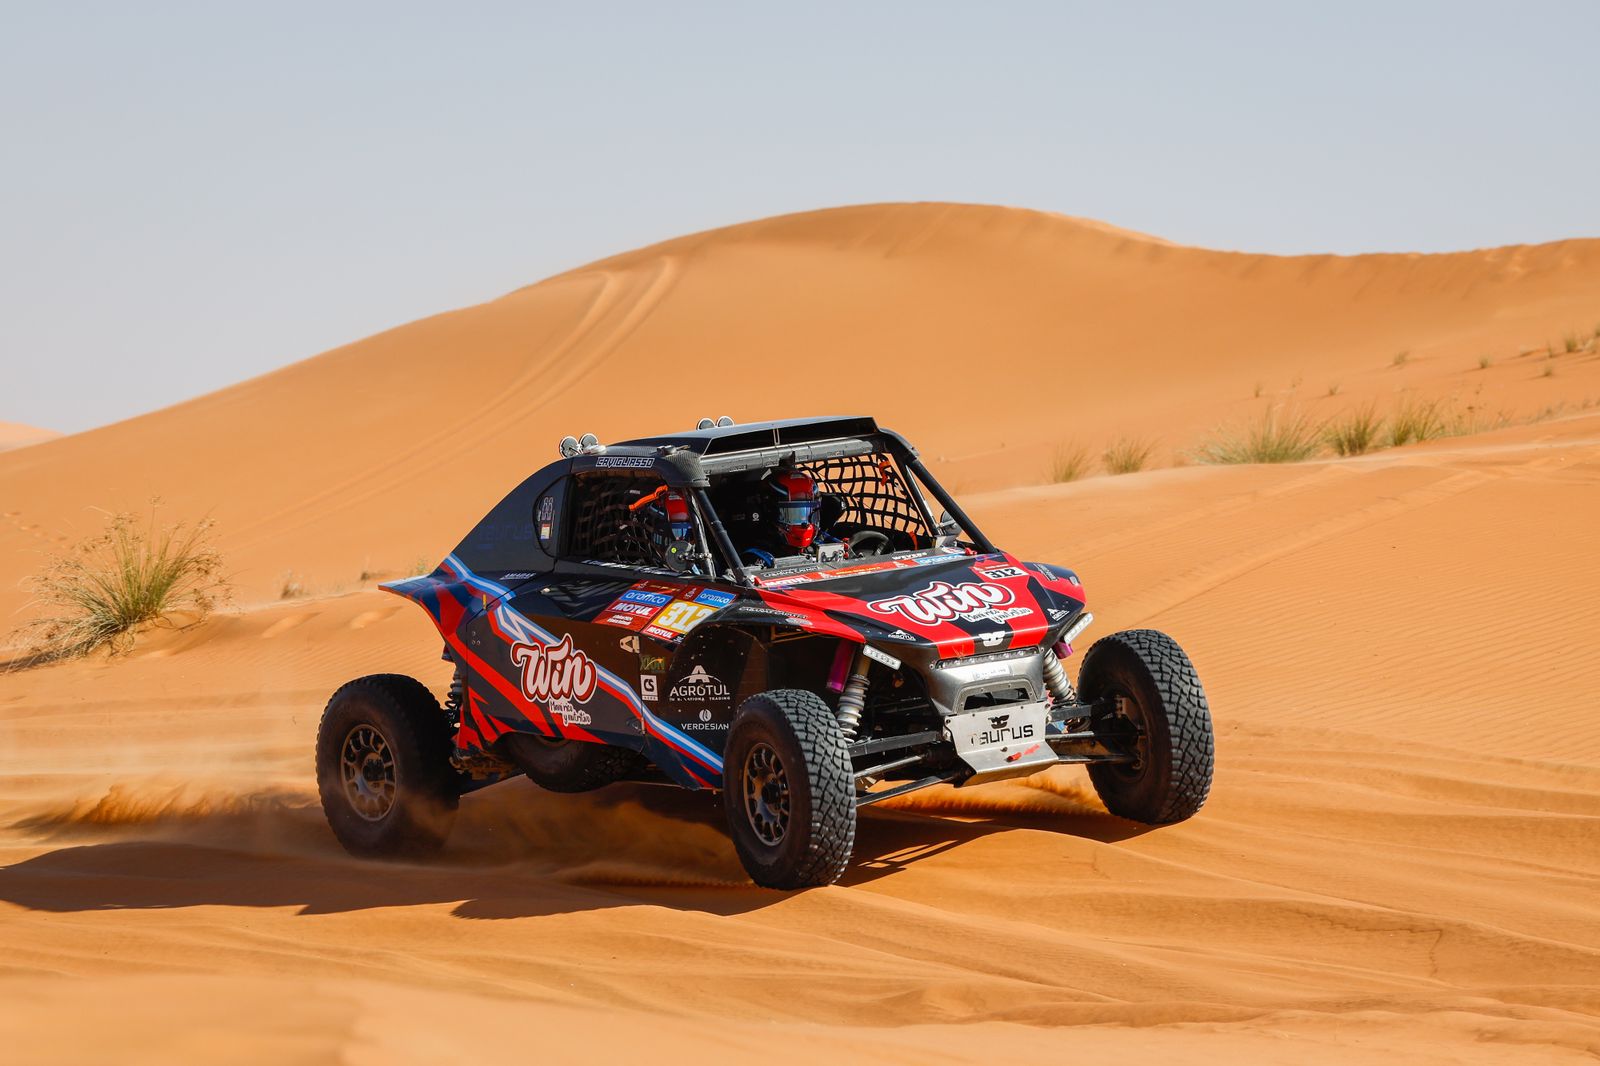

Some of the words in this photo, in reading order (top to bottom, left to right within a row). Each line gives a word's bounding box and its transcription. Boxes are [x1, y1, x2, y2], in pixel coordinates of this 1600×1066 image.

[985, 568, 1022, 579] 312
[626, 592, 667, 604] aramco
[699, 592, 731, 604] aramco
[867, 581, 1016, 626] Win
[611, 602, 654, 617] MOTUL
[657, 602, 714, 633] 312
[646, 625, 674, 639] MOTUL
[511, 633, 598, 704] Win
[669, 684, 731, 697] AGROTUL
[681, 723, 730, 731] VERDESIAN
